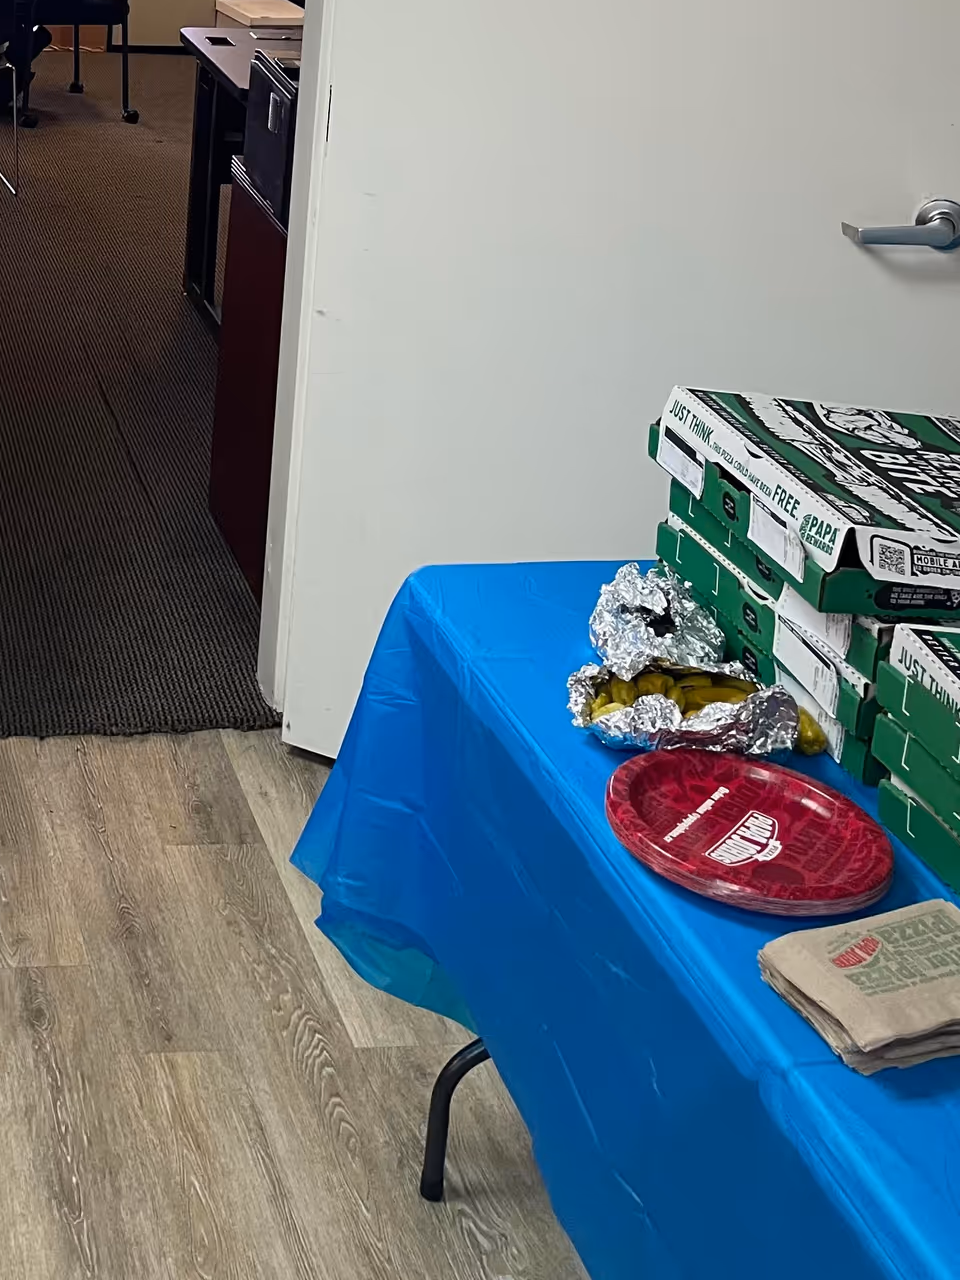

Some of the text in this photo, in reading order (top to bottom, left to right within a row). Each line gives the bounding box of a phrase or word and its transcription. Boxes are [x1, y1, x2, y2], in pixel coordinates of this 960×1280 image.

[669, 399, 691, 425] JUST
[688, 414, 714, 448] THINK.
[721, 450, 734, 466] PIZZA
[734, 460, 749, 479] COULD
[748, 472, 761, 489] HAVE
[760, 481, 773, 497] BEEN
[772, 484, 801, 521] FREE.
[859, 449, 959, 498] BITE
[805, 532, 834, 556] REWARDS
[808, 516, 838, 546] PAPA
[916, 556, 949, 567] MOBILE
[898, 646, 927, 684] JUST
[709, 813, 774, 864] PAPA JOHNS
